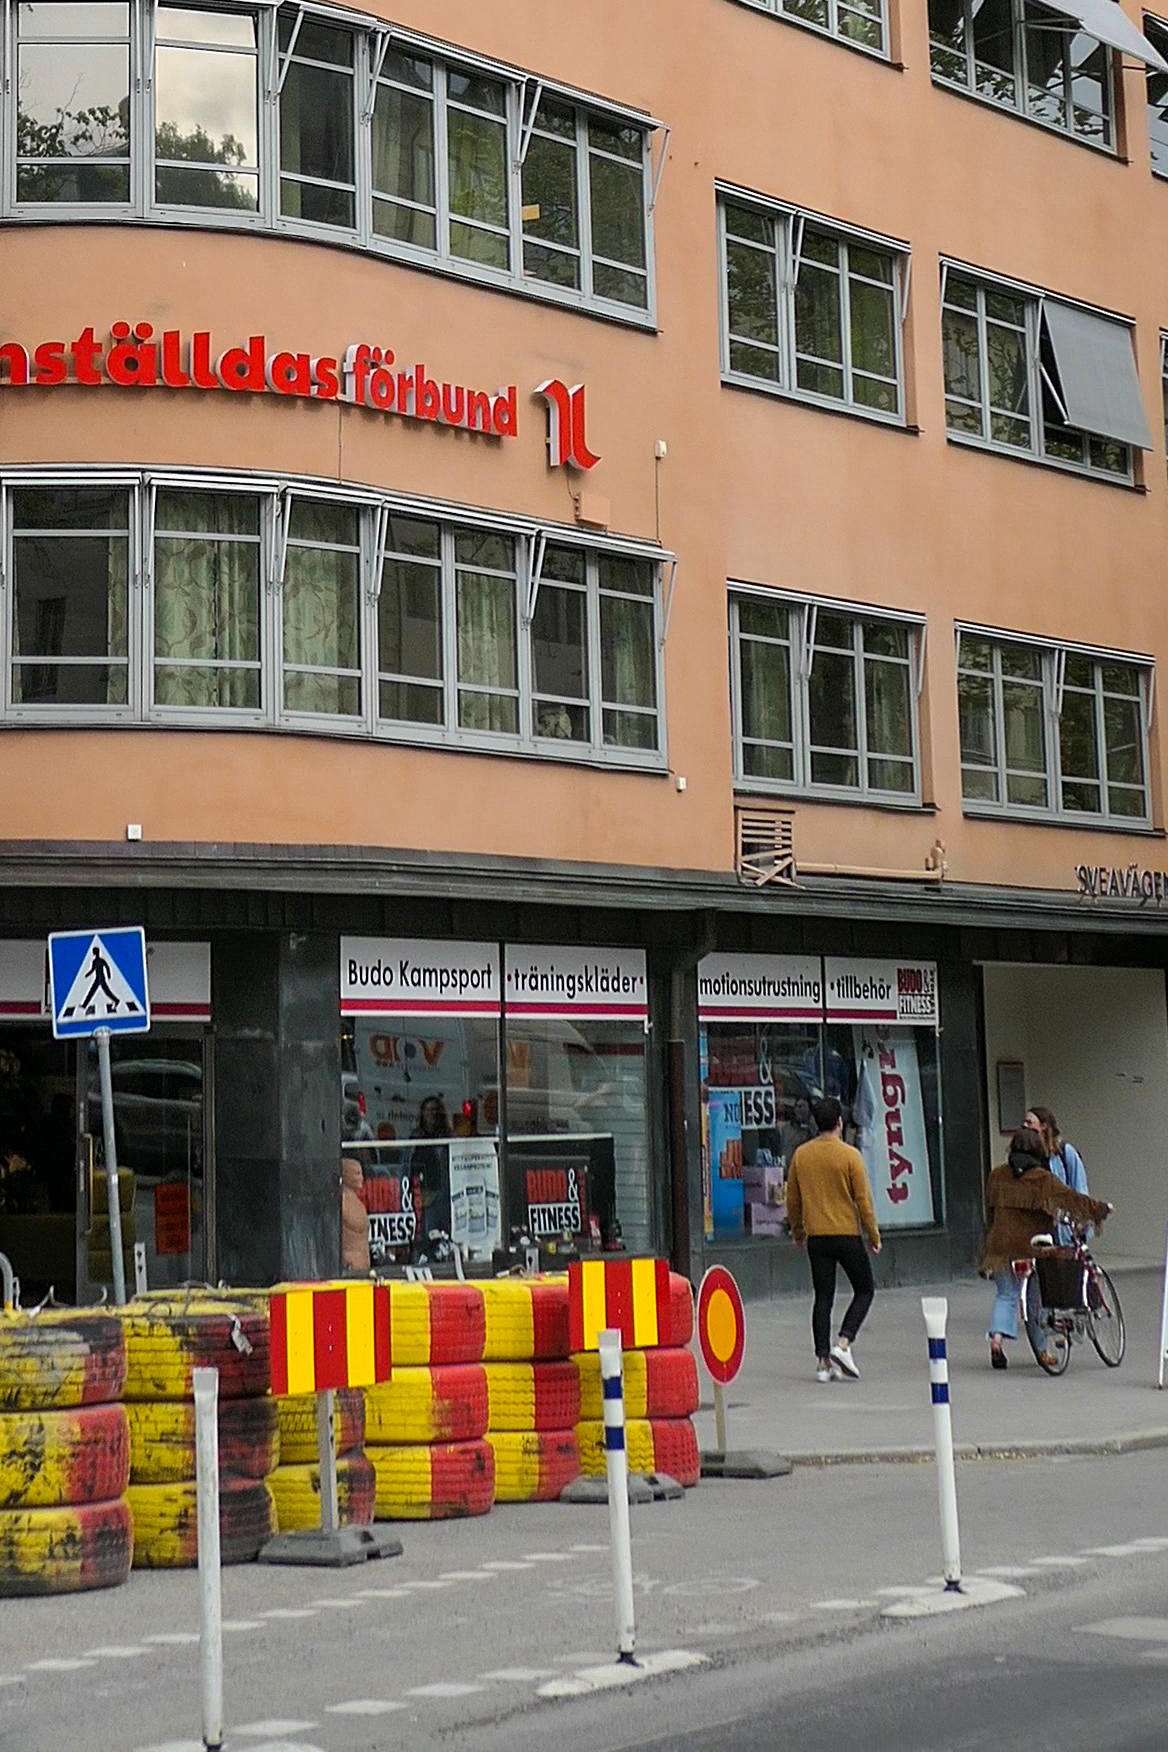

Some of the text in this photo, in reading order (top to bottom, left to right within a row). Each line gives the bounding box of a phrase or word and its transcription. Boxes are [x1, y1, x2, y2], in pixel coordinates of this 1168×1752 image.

[344, 343, 518, 437] förbund
[348, 959, 492, 995] Budo Kampsport
[514, 965, 638, 999] träningskläder
[699, 972, 821, 1004] motionsutrustning
[836, 975, 892, 1000] tillbehör
[896, 968, 923, 992] BUDO
[898, 996, 932, 1015] FITNESS
[530, 1206, 580, 1232] FITNESS
